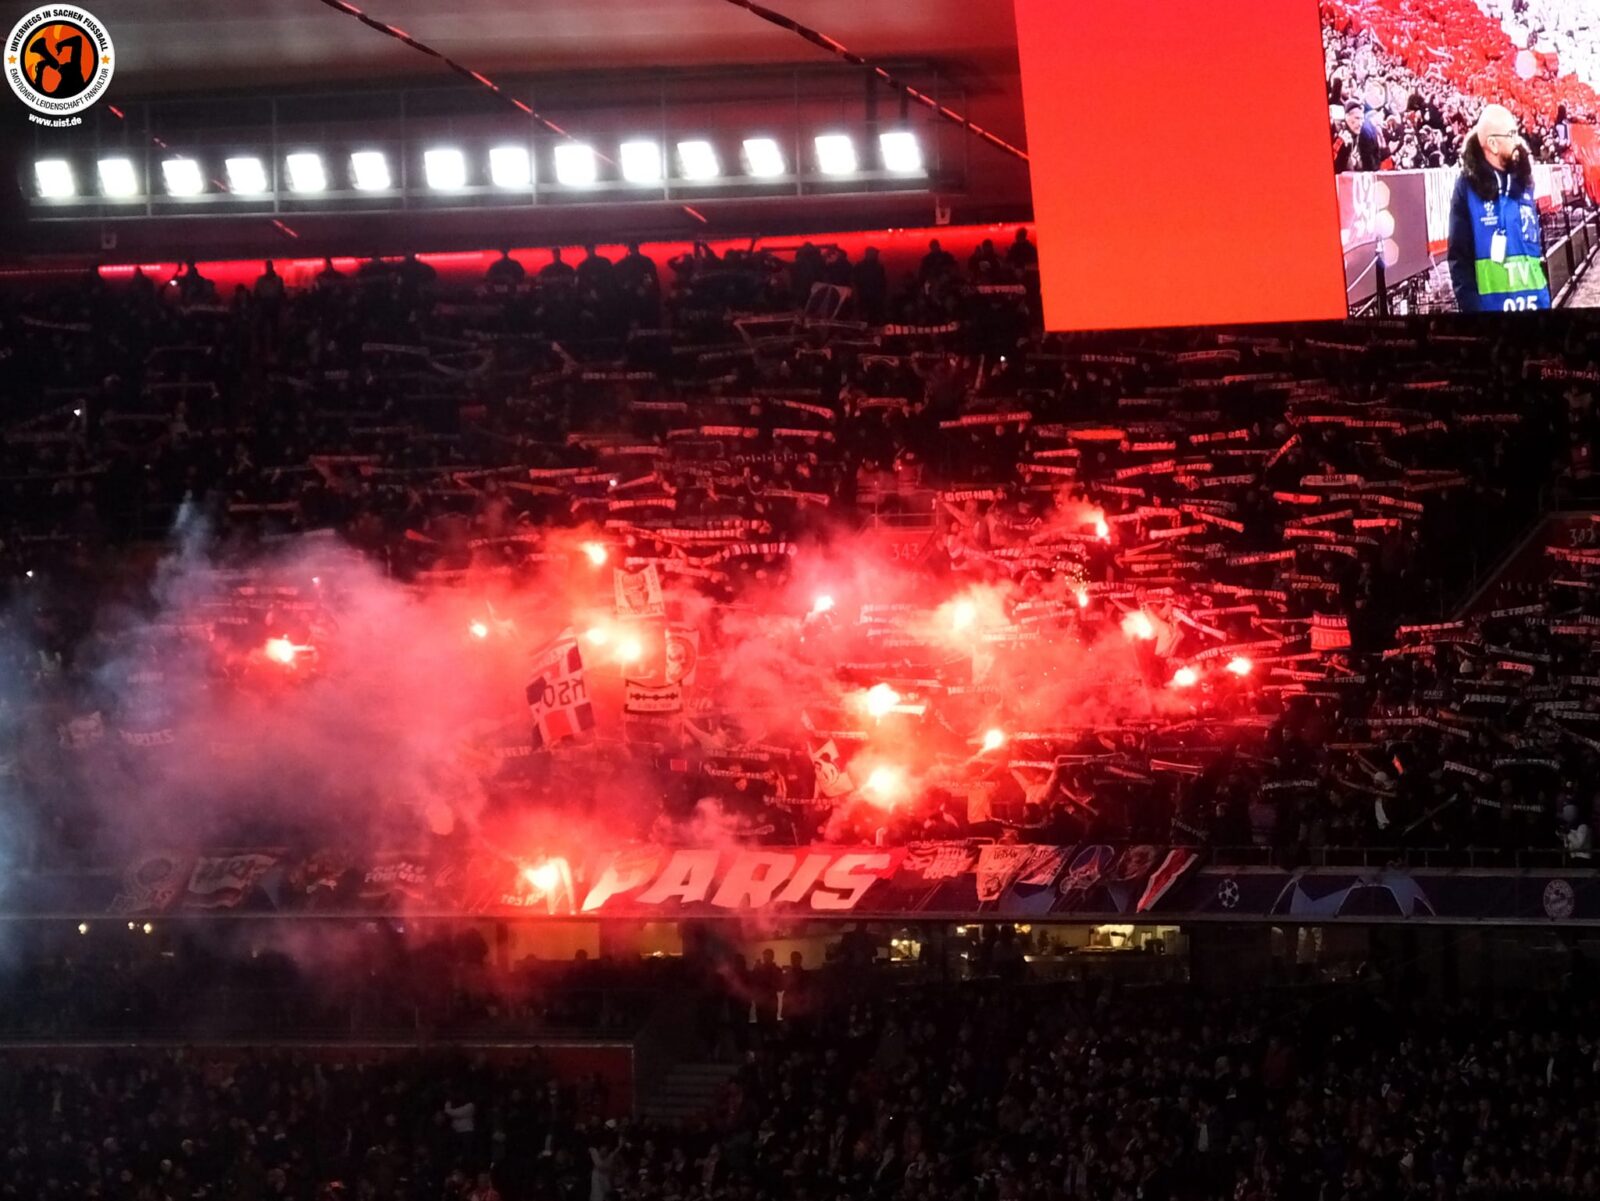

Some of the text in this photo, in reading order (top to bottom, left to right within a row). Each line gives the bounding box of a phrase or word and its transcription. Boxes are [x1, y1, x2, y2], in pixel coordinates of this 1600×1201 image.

[1503, 262, 1531, 287] TV
[890, 543, 920, 561] 343
[580, 848, 891, 913] PARIS
